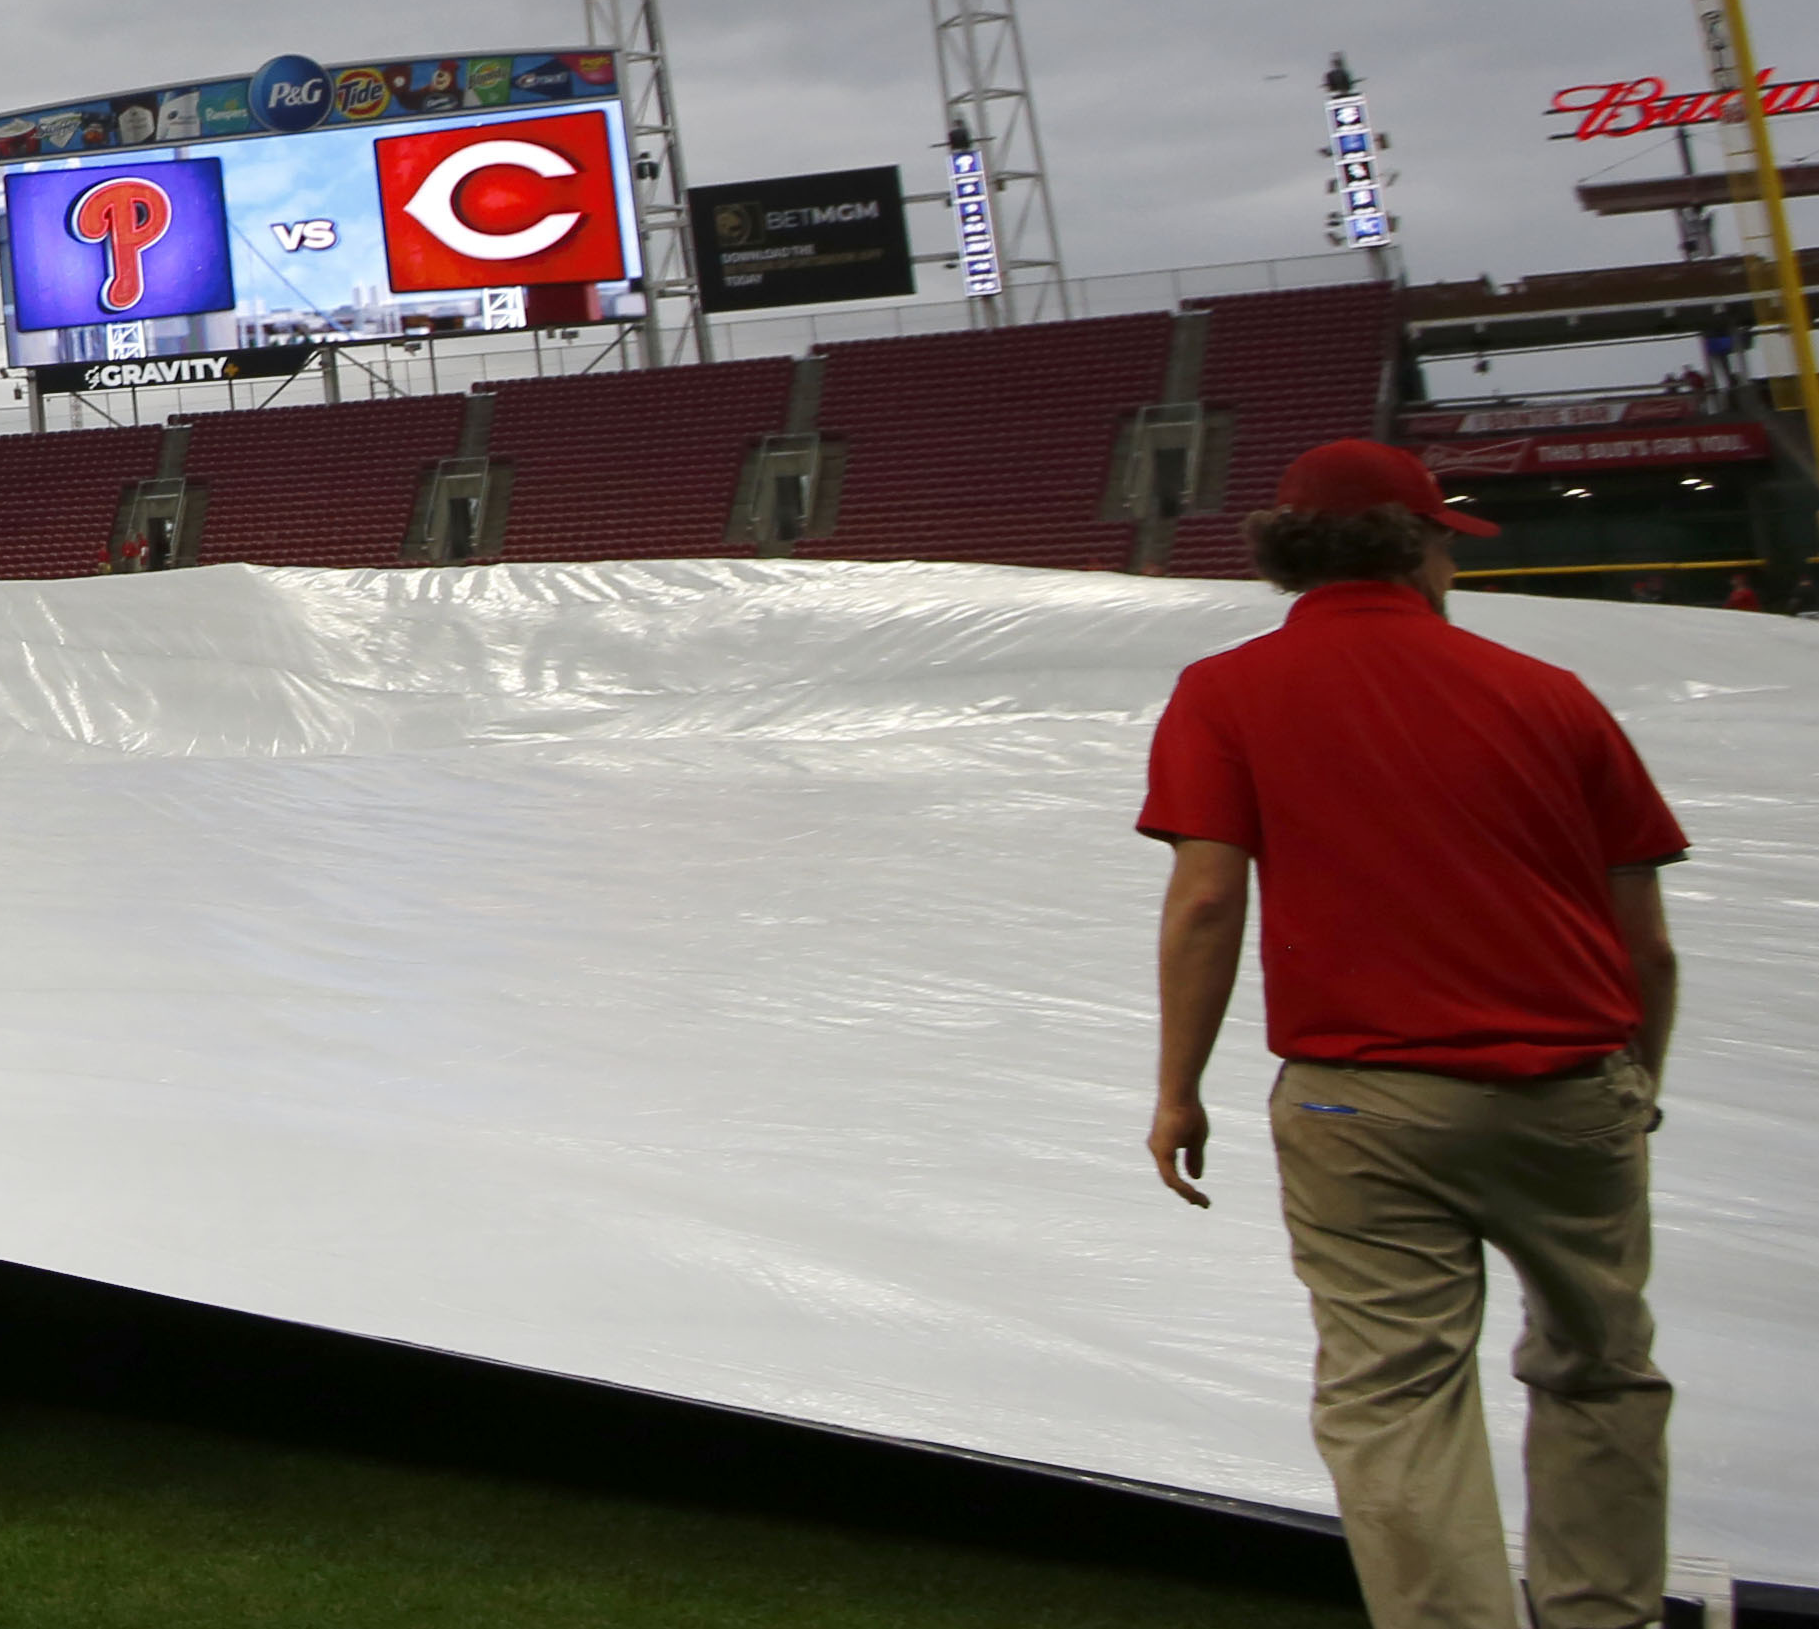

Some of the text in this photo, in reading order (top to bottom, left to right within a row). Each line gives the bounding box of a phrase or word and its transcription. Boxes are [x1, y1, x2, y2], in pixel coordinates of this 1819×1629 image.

[267, 77, 323, 109] P&G
[338, 78, 384, 113] Tide
[764, 200, 881, 230] BETMGM
[271, 219, 336, 251] VS
[100, 356, 229, 388] GRAVITY
